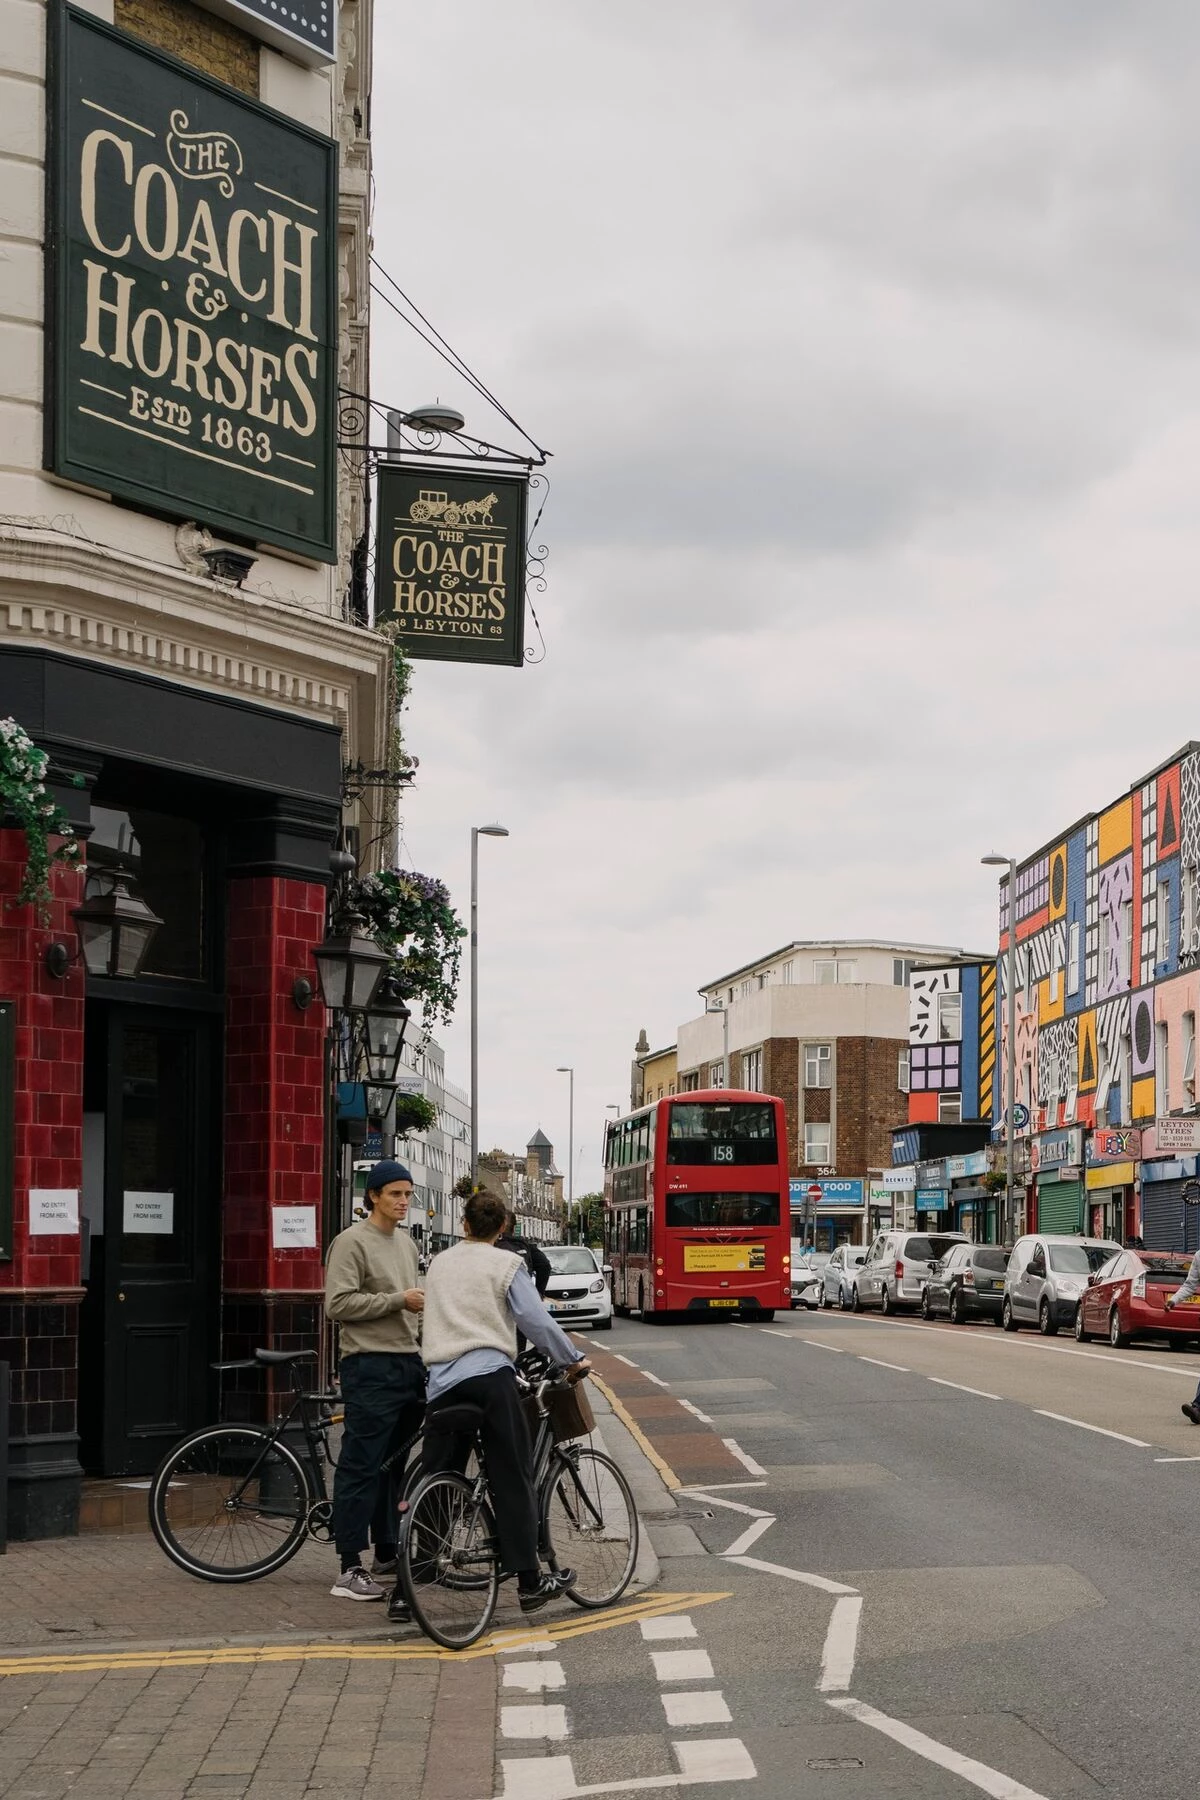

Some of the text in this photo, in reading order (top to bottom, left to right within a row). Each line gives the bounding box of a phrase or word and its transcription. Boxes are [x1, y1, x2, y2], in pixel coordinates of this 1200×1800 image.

[179, 141, 230, 170] THE
[81, 129, 319, 342] COACH
[186, 272, 228, 321] &
[80, 259, 318, 437] HORSES
[201, 413, 272, 463] 1863
[437, 530, 464, 543] THE
[393, 535, 506, 586] COACH
[440, 573, 460, 589] &
[392, 581, 506, 621] HORSES
[413, 618, 484, 634] LEYTON
[490, 625, 503, 634] 63
[714, 1146, 733, 1161] 158
[1096, 1131, 1141, 1156] TOYS
[817, 1167, 837, 1176] 364
[824, 1183, 852, 1192] FOOD
